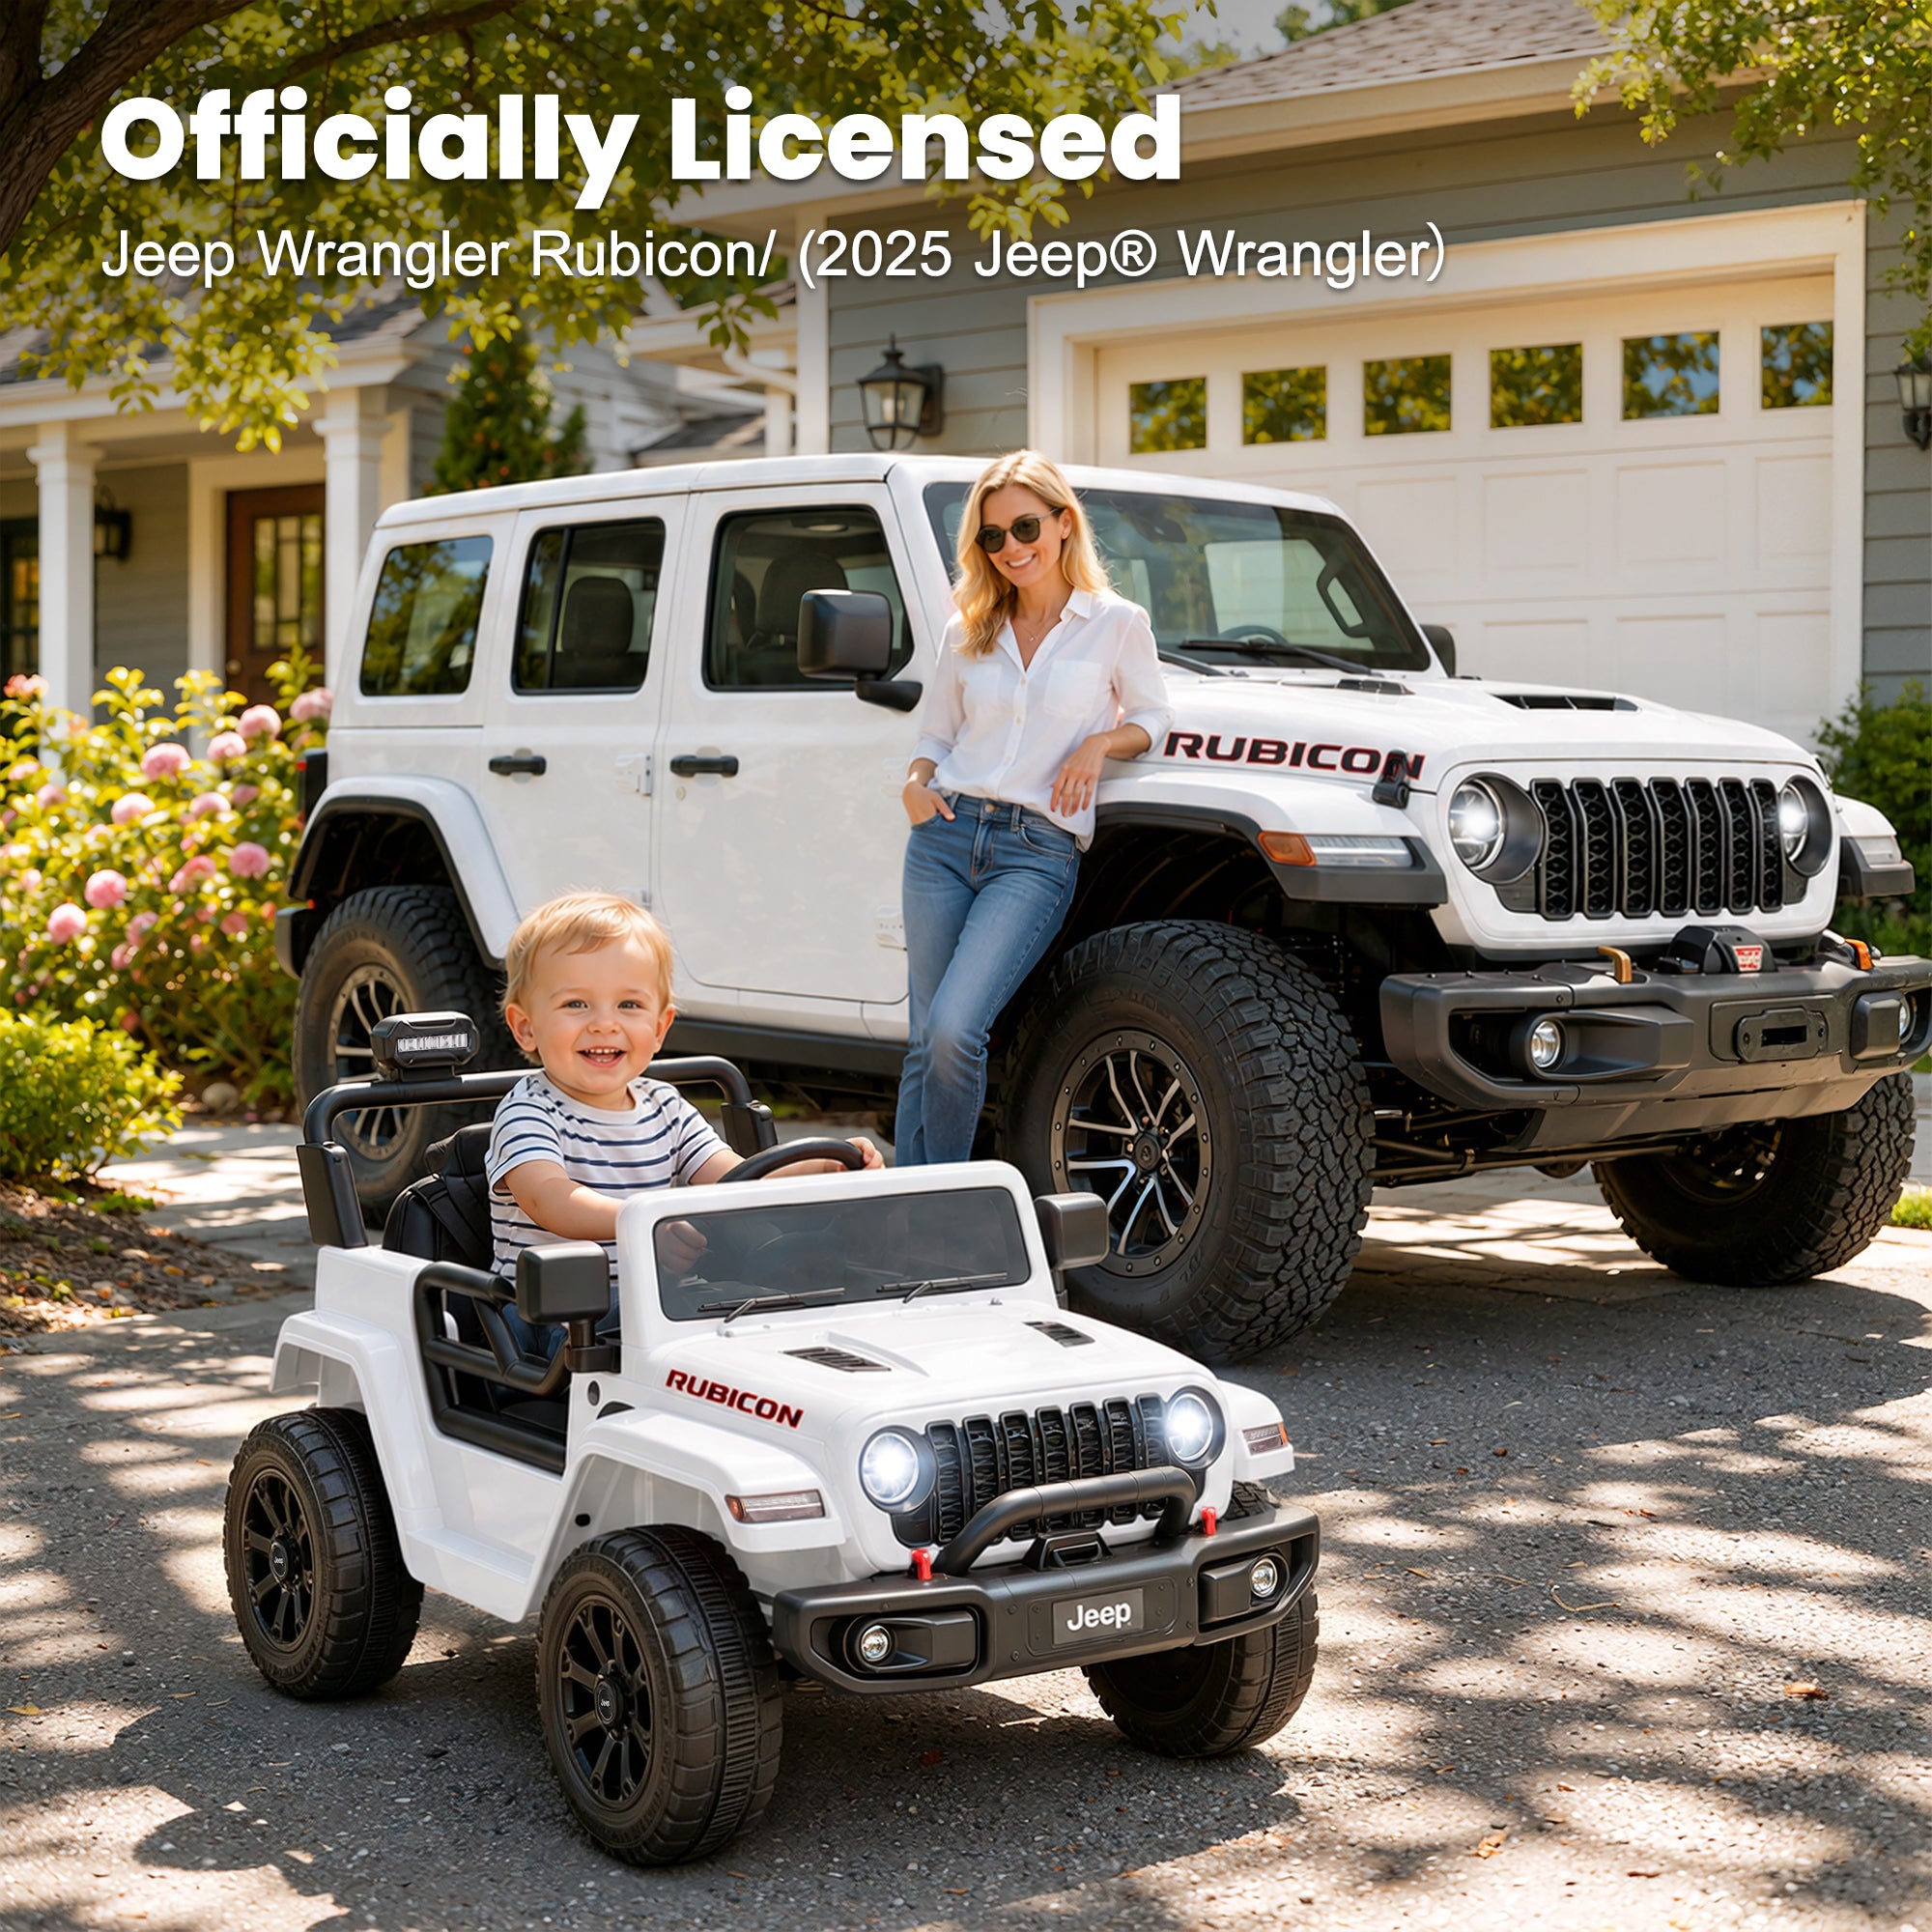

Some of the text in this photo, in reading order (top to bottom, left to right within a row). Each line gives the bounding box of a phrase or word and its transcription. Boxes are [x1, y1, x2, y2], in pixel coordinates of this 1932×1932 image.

[1163, 731, 1426, 780] RUBICON
[665, 1369, 805, 1429] RUBICON
[1066, 1603, 1132, 1632] Jeep
